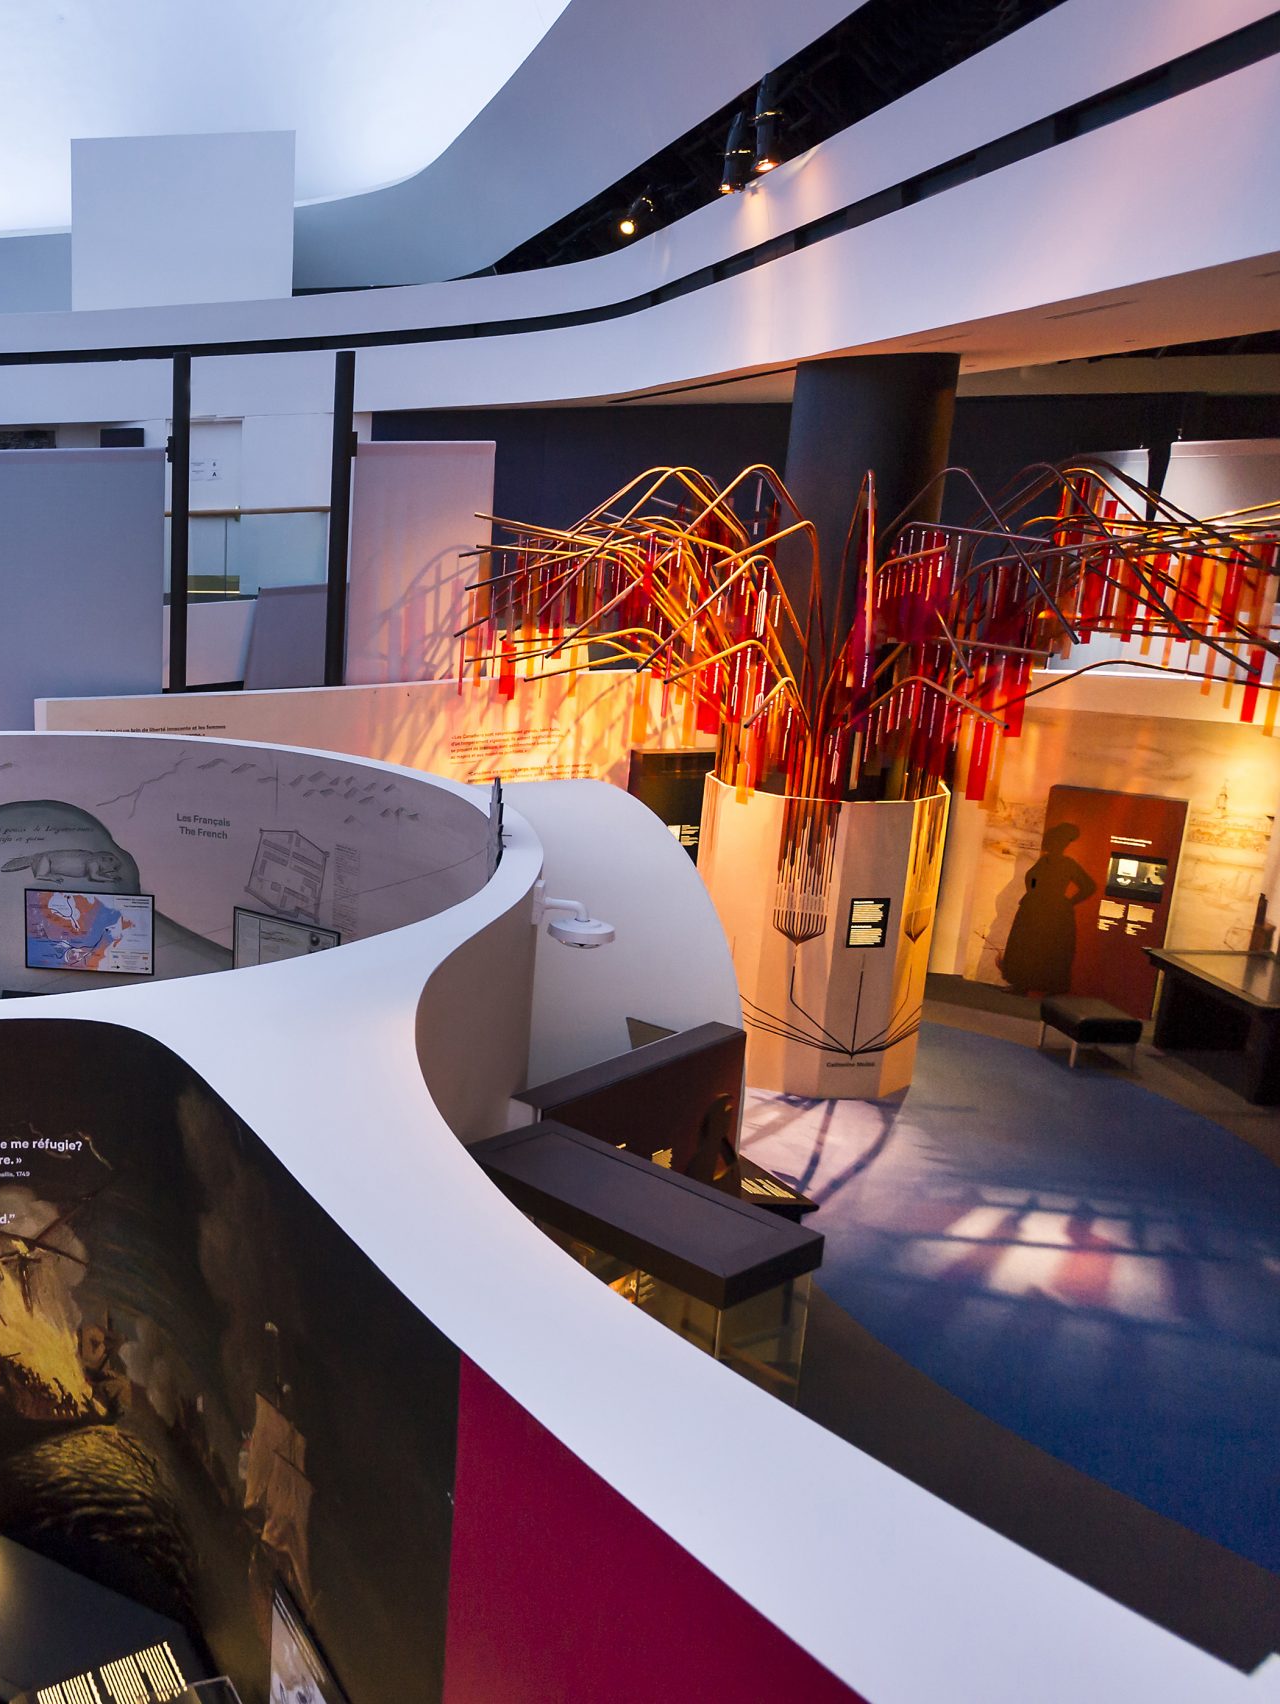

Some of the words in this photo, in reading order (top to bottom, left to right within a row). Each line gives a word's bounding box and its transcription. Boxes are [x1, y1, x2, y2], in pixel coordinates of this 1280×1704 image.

[176, 813, 192, 822] Les
[193, 815, 231, 827] Français
[179, 826, 196, 836] The
[198, 828, 228, 839] French
[10, 1141, 29, 1149] me
[32, 1138, 83, 1151] réfugie?
